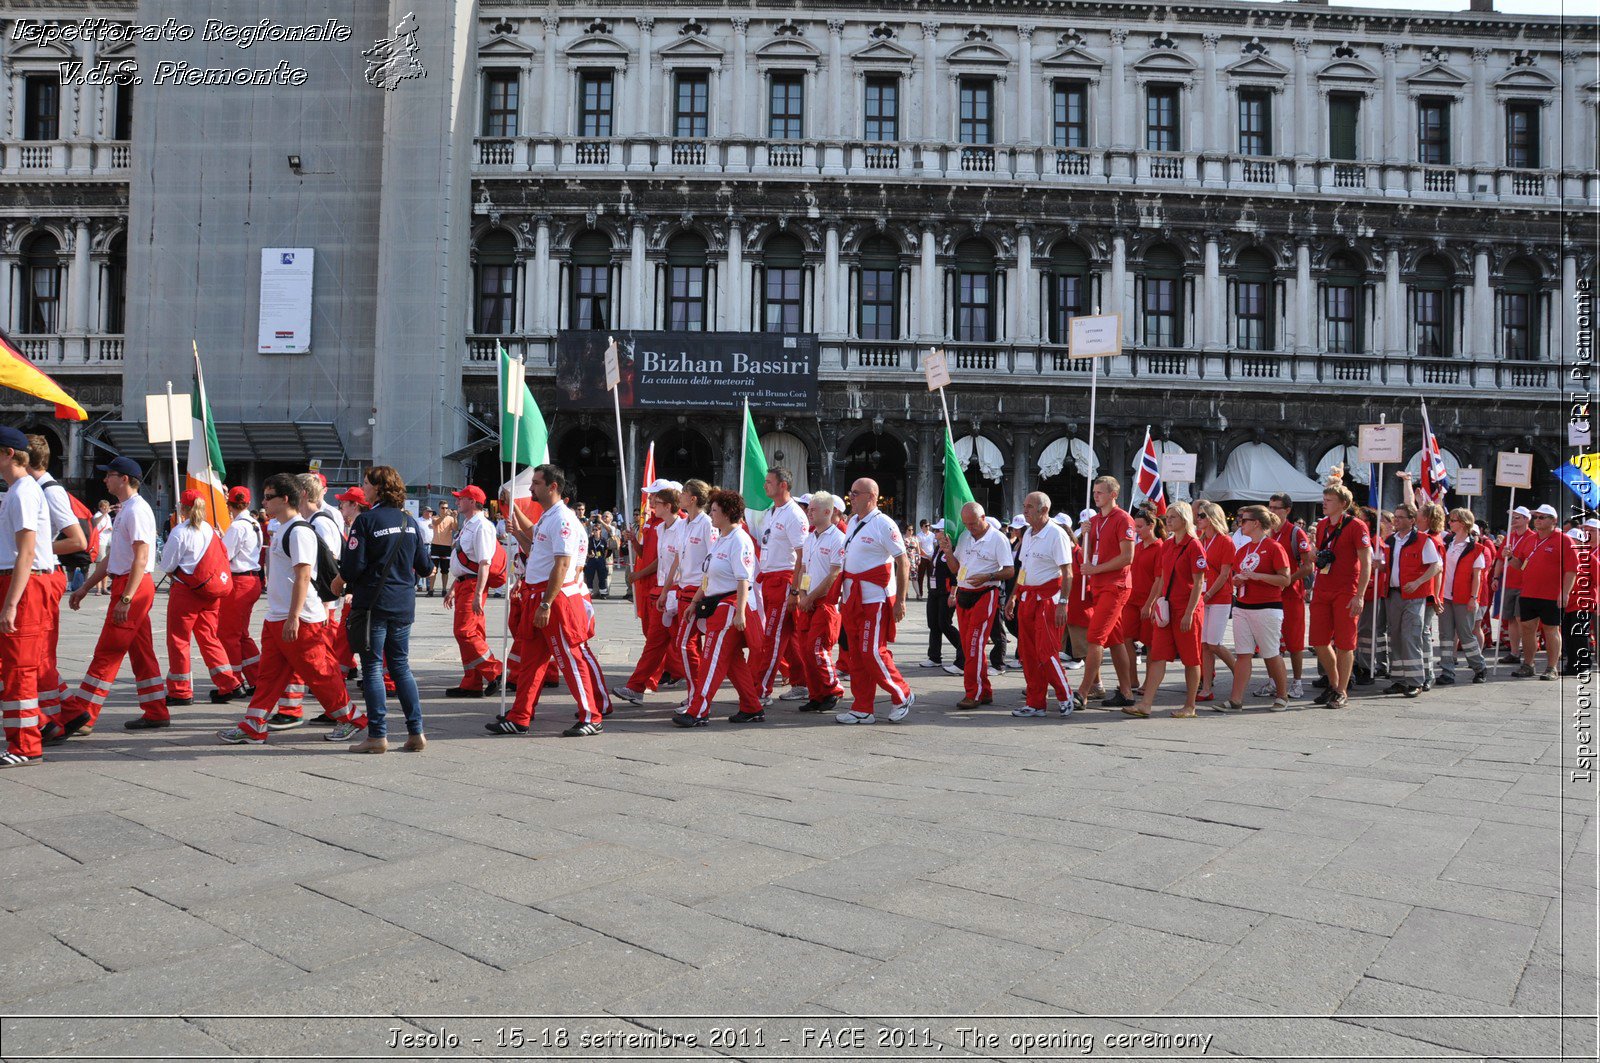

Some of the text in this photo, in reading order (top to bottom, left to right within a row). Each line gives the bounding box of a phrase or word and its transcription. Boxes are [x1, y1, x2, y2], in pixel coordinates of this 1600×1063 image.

[641, 352, 810, 374] Bizhan Bassiri
[641, 374, 754, 386] La caduta delle meteoriti
